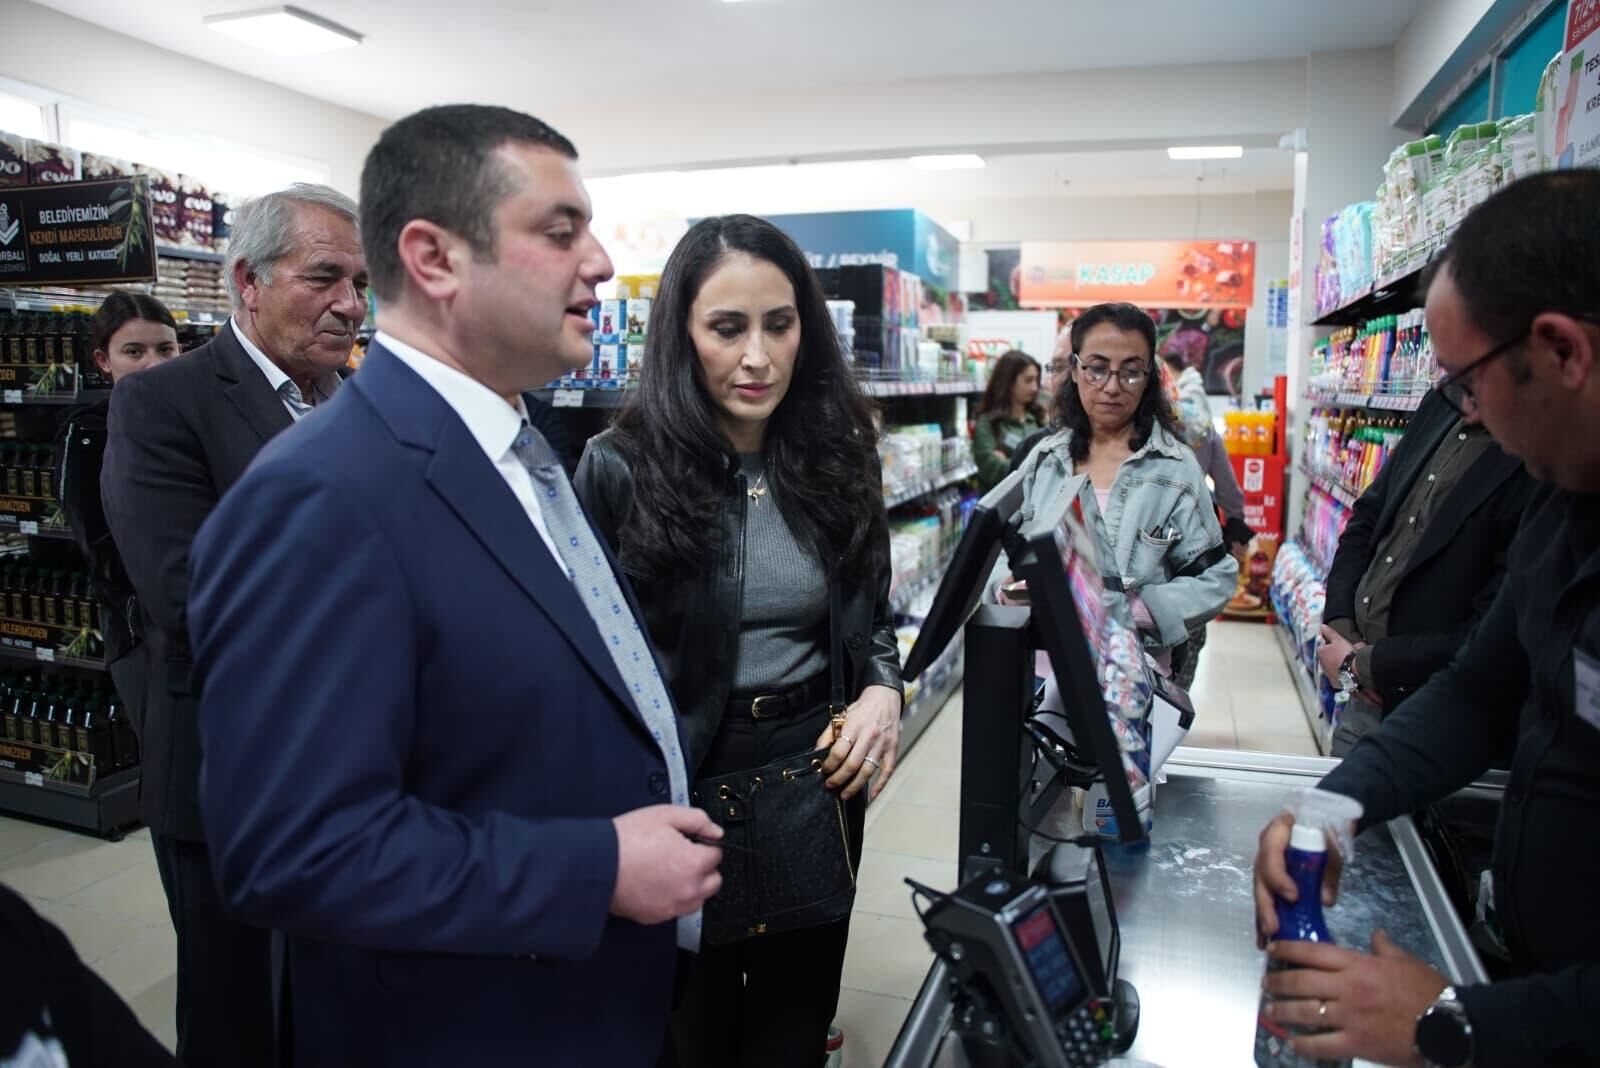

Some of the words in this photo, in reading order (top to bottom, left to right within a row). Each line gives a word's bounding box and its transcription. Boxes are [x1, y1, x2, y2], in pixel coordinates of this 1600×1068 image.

[184, 197, 212, 211] evo
[39, 204, 109, 225] BELEDİYEMİZİN
[30, 228, 59, 246] KENDİ
[60, 224, 123, 242] MAHSULÜDÜR
[39, 249, 62, 263] DOĞAL
[66, 249, 84, 262] YERLİ
[88, 249, 118, 261] KATKISIZ
[840, 250, 898, 267] PEYNİR
[1078, 263, 1155, 284] KASAP
